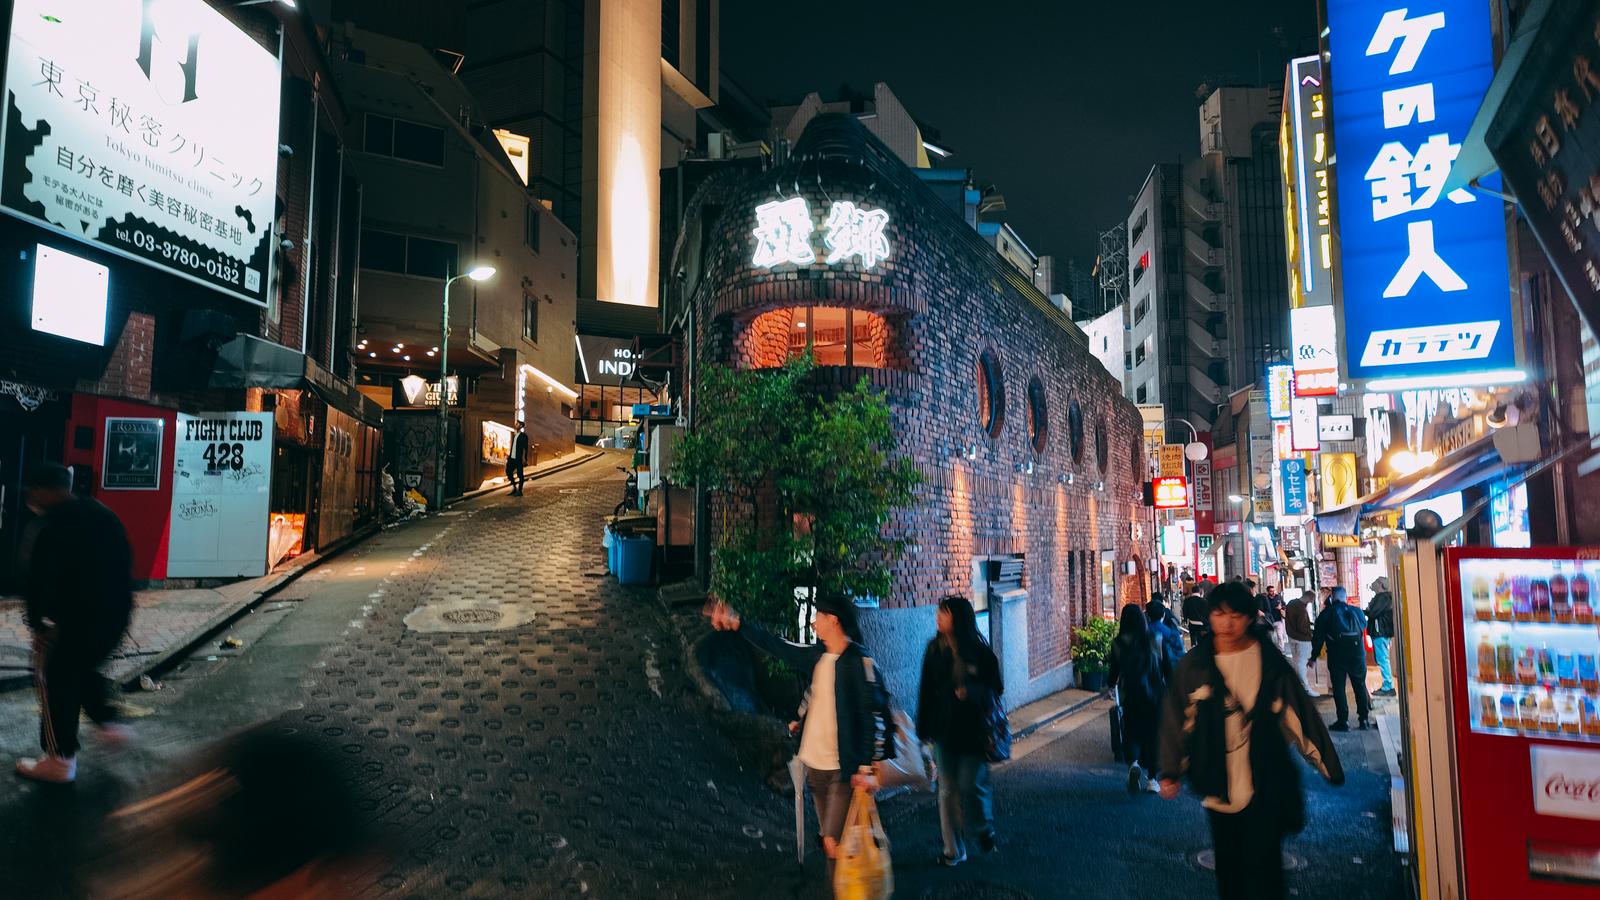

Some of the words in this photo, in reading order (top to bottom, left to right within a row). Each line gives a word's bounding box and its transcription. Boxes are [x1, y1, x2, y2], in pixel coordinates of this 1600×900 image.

[32, 56, 264, 198] 東京秘密クリニック
[104, 134, 142, 164] Tokyo
[144, 154, 185, 184] himitsu
[186, 178, 216, 199] clinic
[41, 174, 104, 209] モテる大人には
[54, 193, 100, 221] 秘密がある
[56, 145, 244, 247] 自分を磨く美容秘密基地
[115, 227, 132, 244] tel.
[133, 229, 241, 286] 03-3780-0132
[1376, 331, 1482, 357] カラテツ
[185, 419, 227, 442] FIGHT
[229, 419, 263, 442] CLUB
[202, 442, 244, 472] 428
[1201, 477, 1211, 505] LABI
[1288, 473, 1303, 509] セキネ
